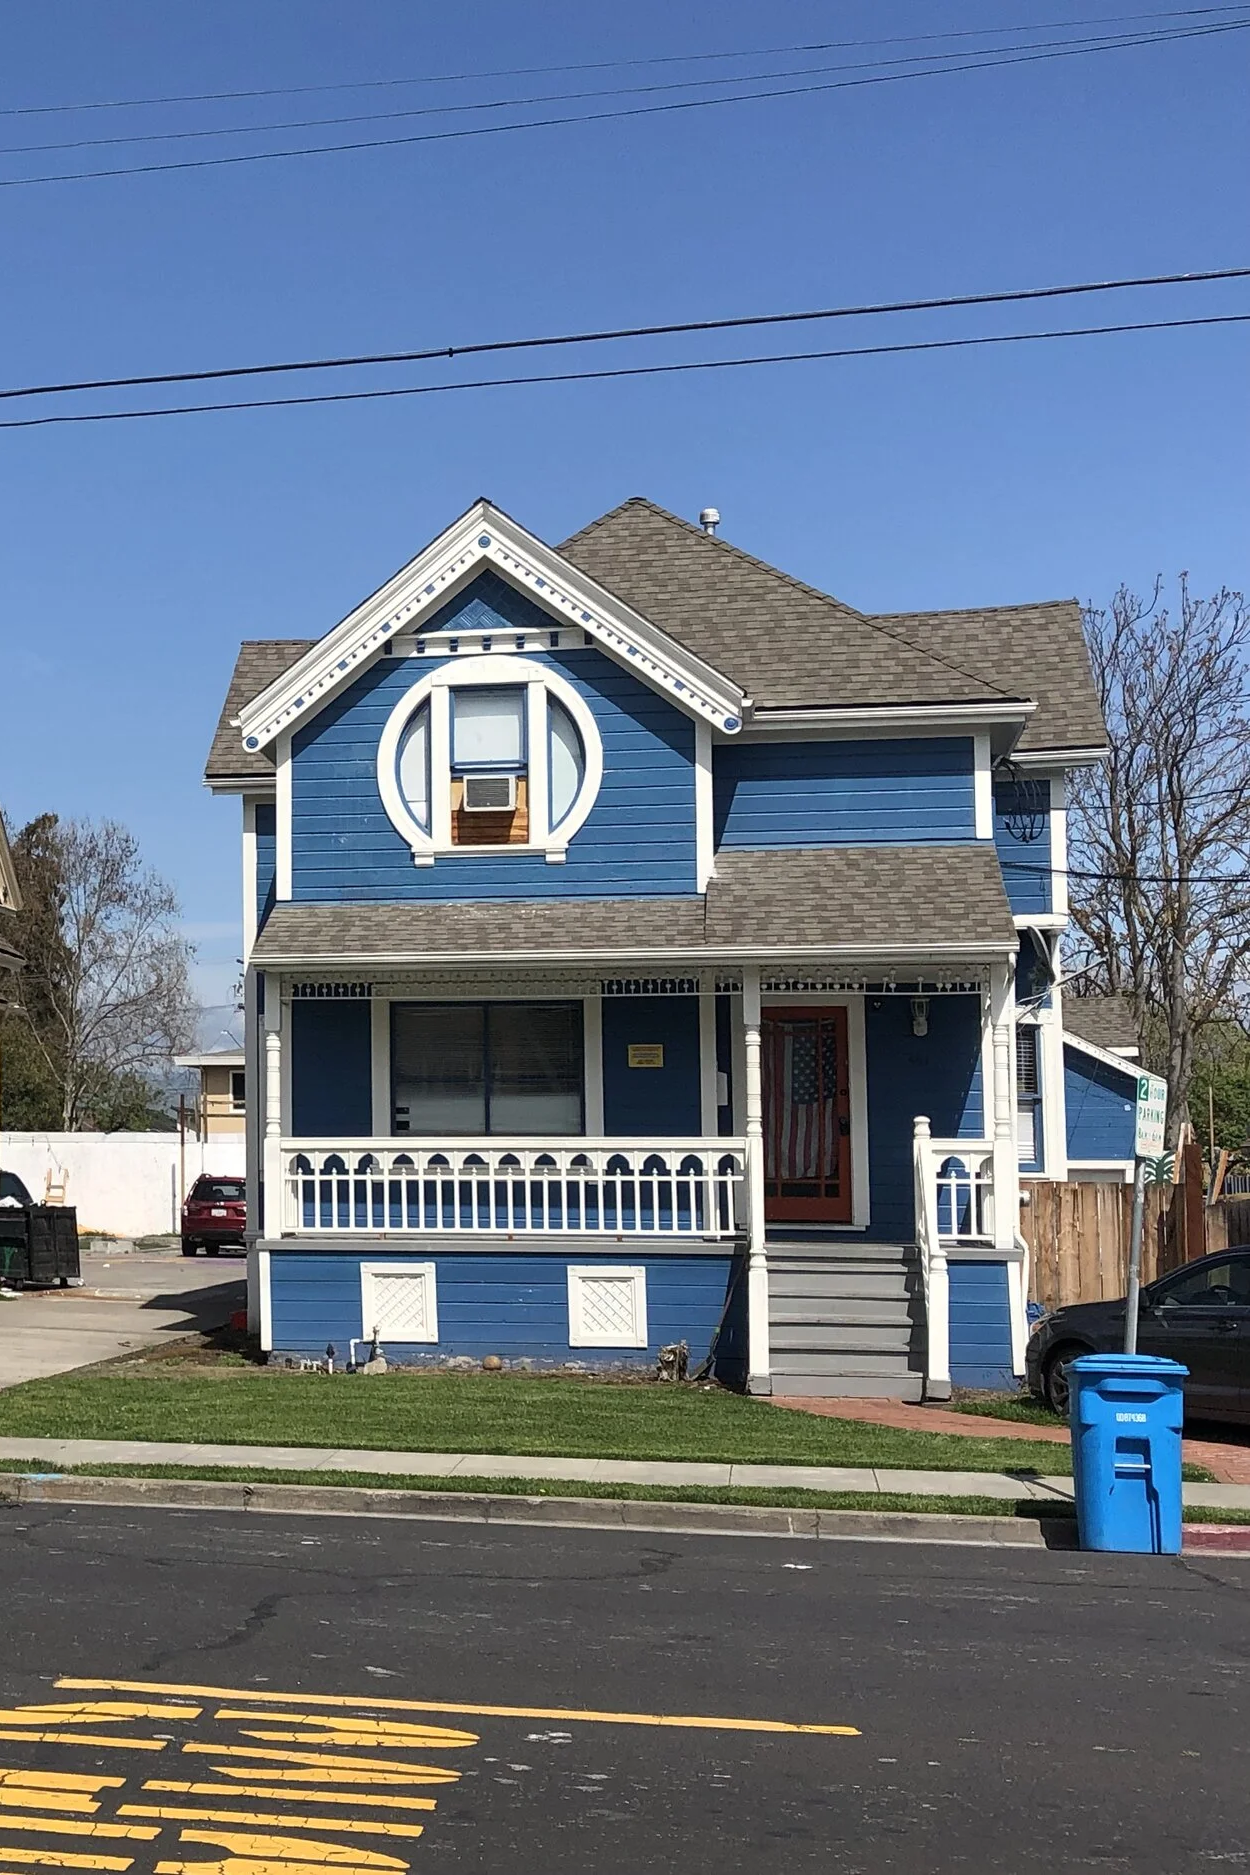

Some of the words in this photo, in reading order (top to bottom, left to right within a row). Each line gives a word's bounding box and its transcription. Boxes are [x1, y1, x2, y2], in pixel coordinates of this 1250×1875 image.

[1140, 1079, 1148, 1099] 2
[1150, 1084, 1165, 1100] HOUR
[1138, 1106, 1164, 1124] PARKING
